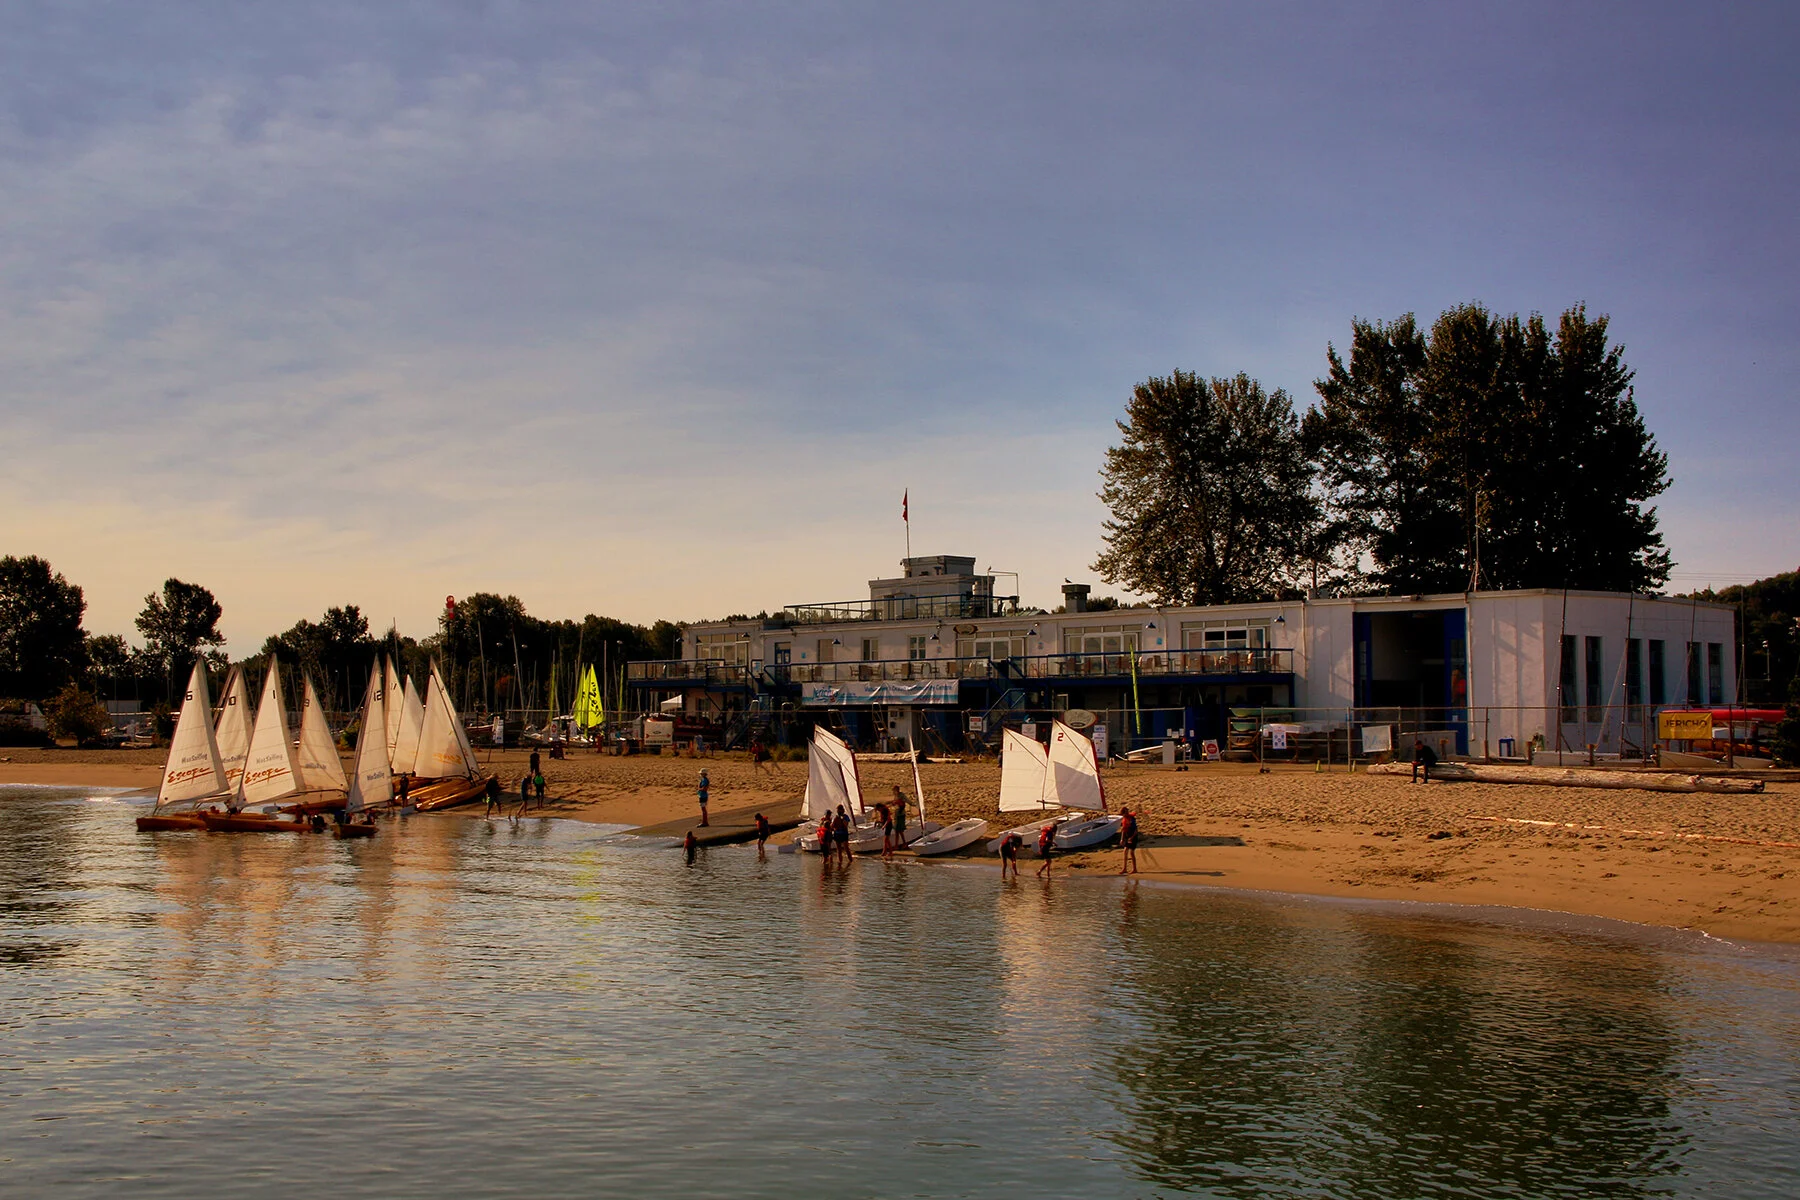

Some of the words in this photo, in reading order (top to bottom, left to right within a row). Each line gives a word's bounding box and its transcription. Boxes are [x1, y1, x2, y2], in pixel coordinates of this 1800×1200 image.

[185, 690, 193, 701] 6
[373, 689, 382, 701] 12
[1663, 719, 1708, 728] JERICHO
[1057, 732, 1064, 742] 2
